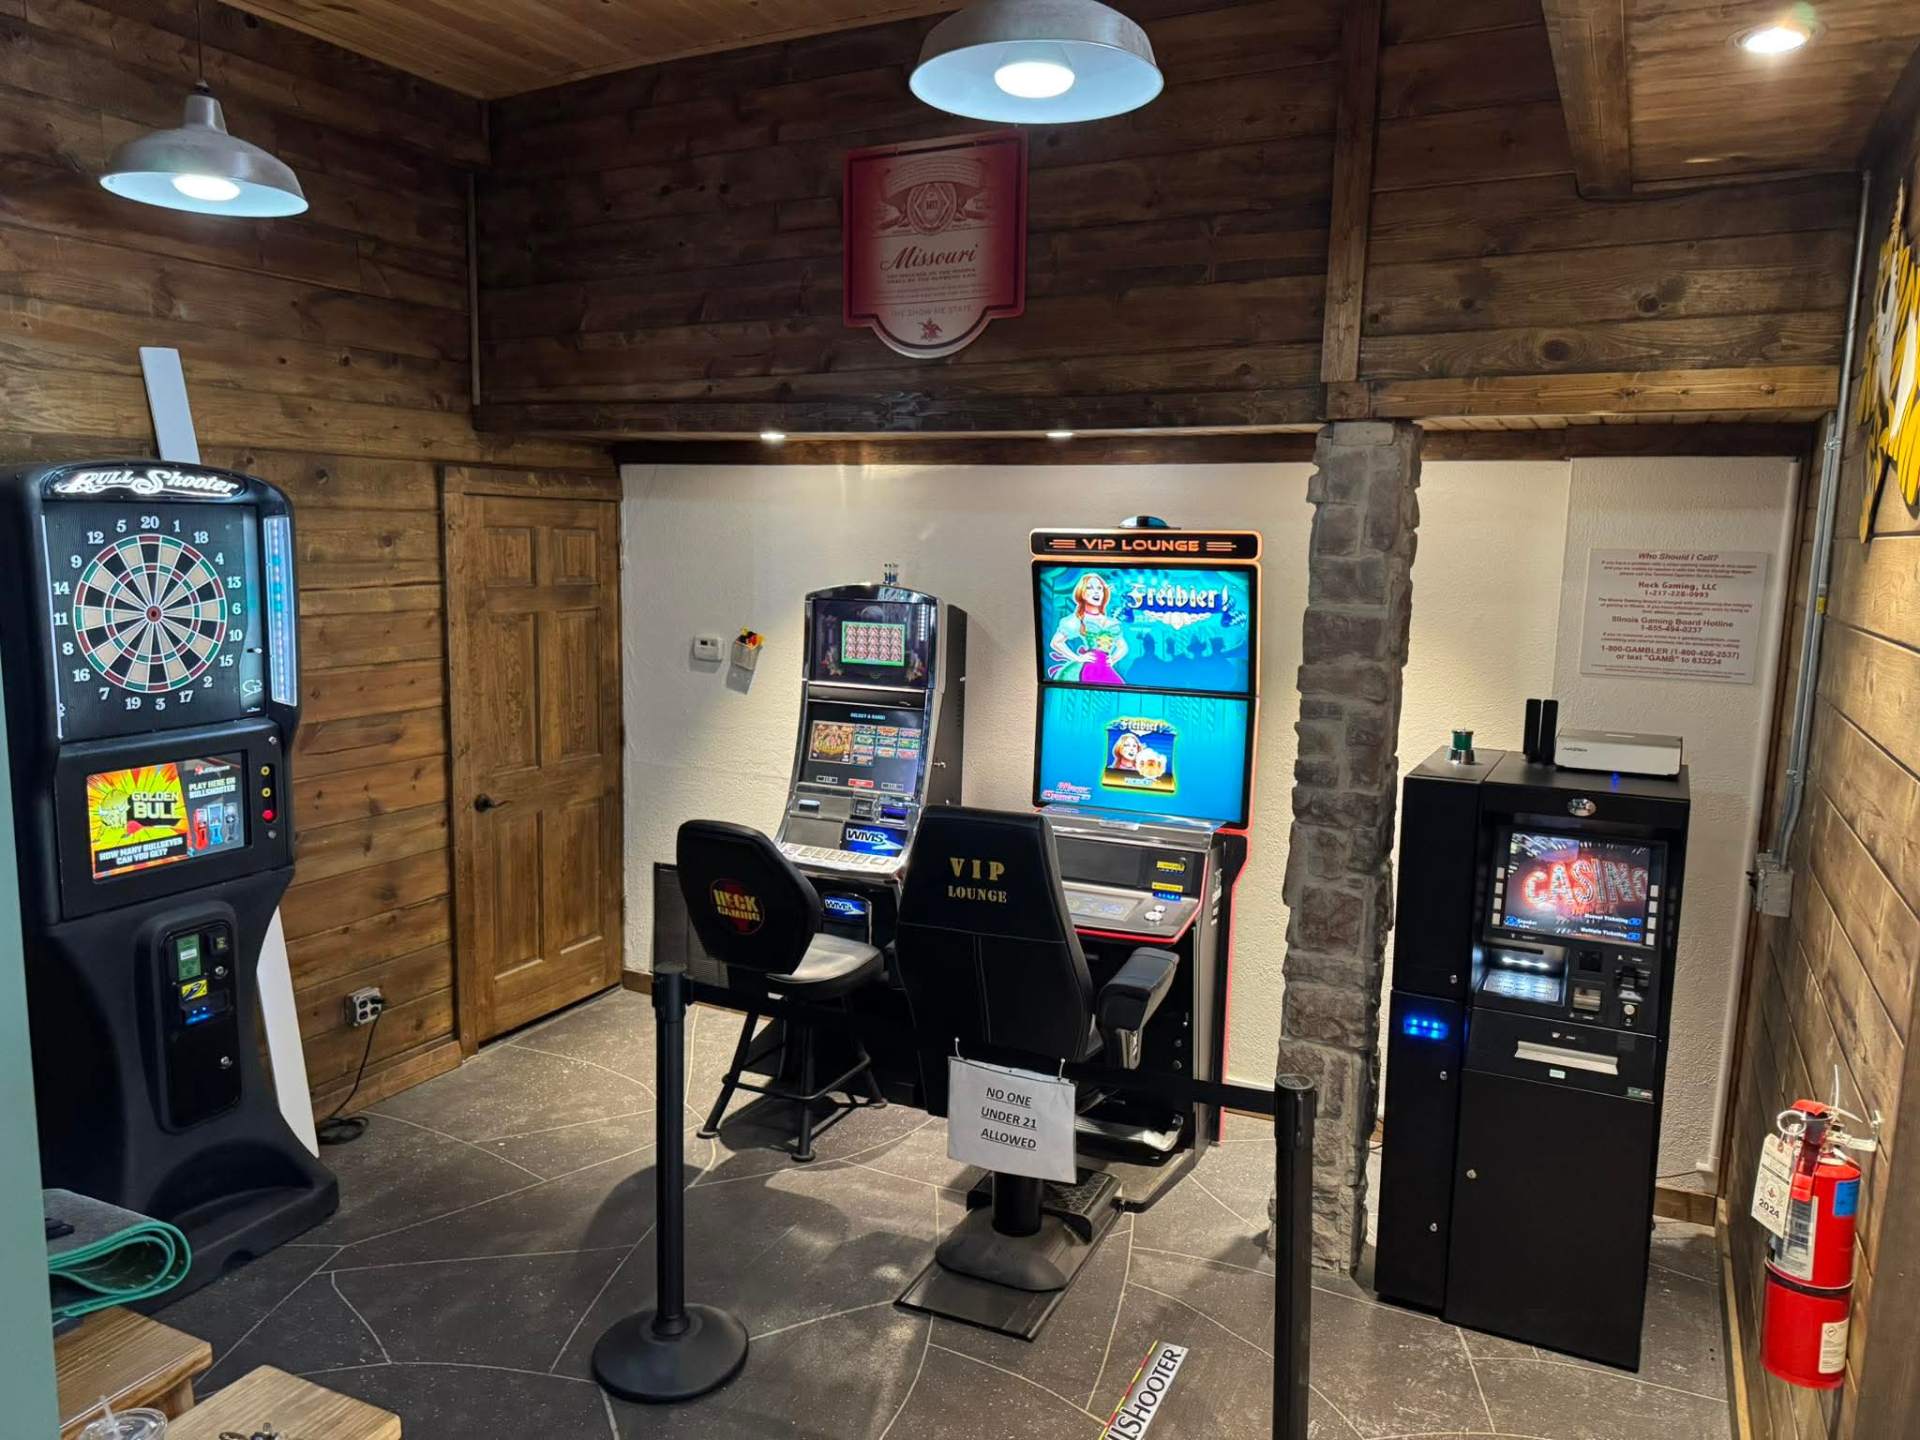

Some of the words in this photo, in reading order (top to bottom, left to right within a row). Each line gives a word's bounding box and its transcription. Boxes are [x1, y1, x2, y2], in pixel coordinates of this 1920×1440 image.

[880, 243, 979, 271] Missouri
[117, 520, 126, 532] 5
[140, 517, 160, 530] 20
[174, 520, 180, 532] 1
[88, 532, 104, 544] 12
[194, 532, 208, 544] 18
[1082, 539, 1116, 549] VIP
[1122, 539, 1199, 551] LOUNGE
[71, 556, 82, 567] 9
[215, 552, 224, 564] 4
[1659, 553, 1689, 561] Should
[54, 582, 70, 594] 14
[227, 576, 241, 589] 13
[1662, 582, 1698, 591] Gaming,
[1702, 583, 1717, 591] LLC
[232, 603, 241, 614] 6
[54, 613, 68, 625] 11
[1612, 616, 1639, 624] Illinois
[1641, 617, 1674, 627] Gaming
[1676, 618, 1702, 626] Board
[1703, 620, 1734, 628] Hotline
[229, 630, 243, 642] 10
[62, 643, 74, 655] 8
[220, 656, 233, 667] 15
[73, 670, 90, 682] 16
[203, 676, 212, 688] 2
[100, 687, 110, 700] 7
[179, 690, 194, 702] 17
[125, 698, 142, 710] 19
[156, 698, 166, 710] 3
[132, 791, 178, 802] GOLDEN
[134, 802, 176, 819] BULL
[847, 828, 887, 844] WMS
[99, 850, 120, 861] HOW
[121, 845, 144, 856] MANY
[116, 854, 133, 865] CAN
[134, 851, 149, 862] YOU
[949, 857, 1005, 880] VIP
[713, 888, 758, 912] HECK
[948, 885, 1007, 904] LOUNGE
[986, 1087, 1004, 1100] NO
[1007, 1092, 1032, 1106] ONE
[980, 1106, 1020, 1125] UNDER
[1022, 1117, 1037, 1129] 21
[980, 1128, 1037, 1149] ALLOWED
[1758, 1198, 1780, 1219] 2024
